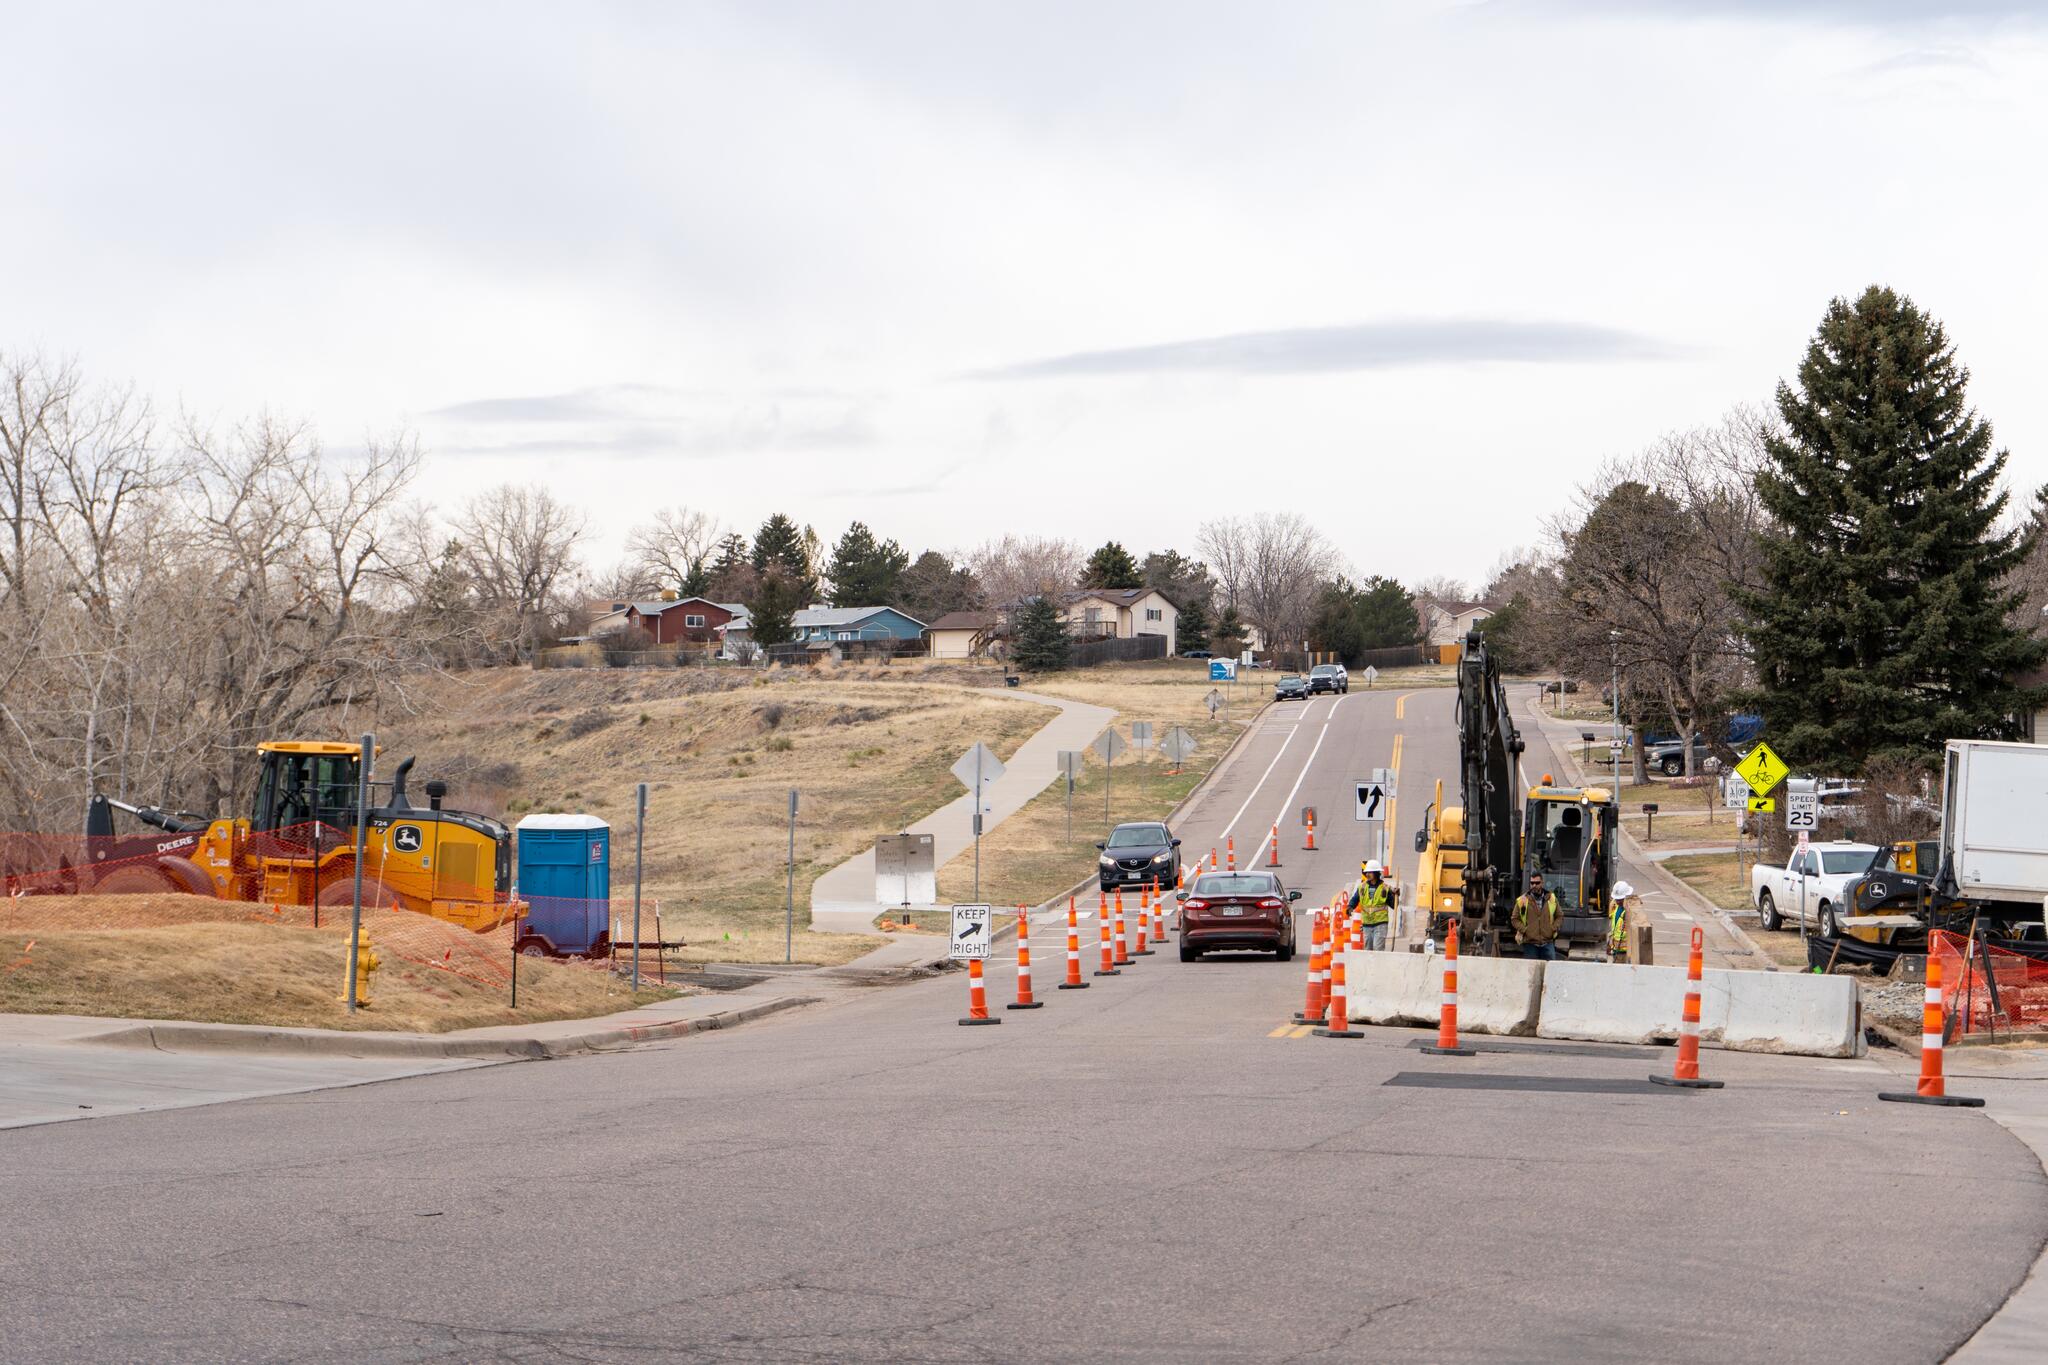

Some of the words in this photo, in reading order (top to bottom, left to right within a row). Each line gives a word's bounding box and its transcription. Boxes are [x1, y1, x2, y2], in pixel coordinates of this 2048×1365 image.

[1729, 799, 1746, 807] ONLY
[1789, 795, 1816, 803] SPEED
[1789, 811, 1814, 826] 25
[156, 835, 195, 853] DEERE
[957, 909, 986, 920] KEEP
[953, 943, 988, 954] RIGHT
